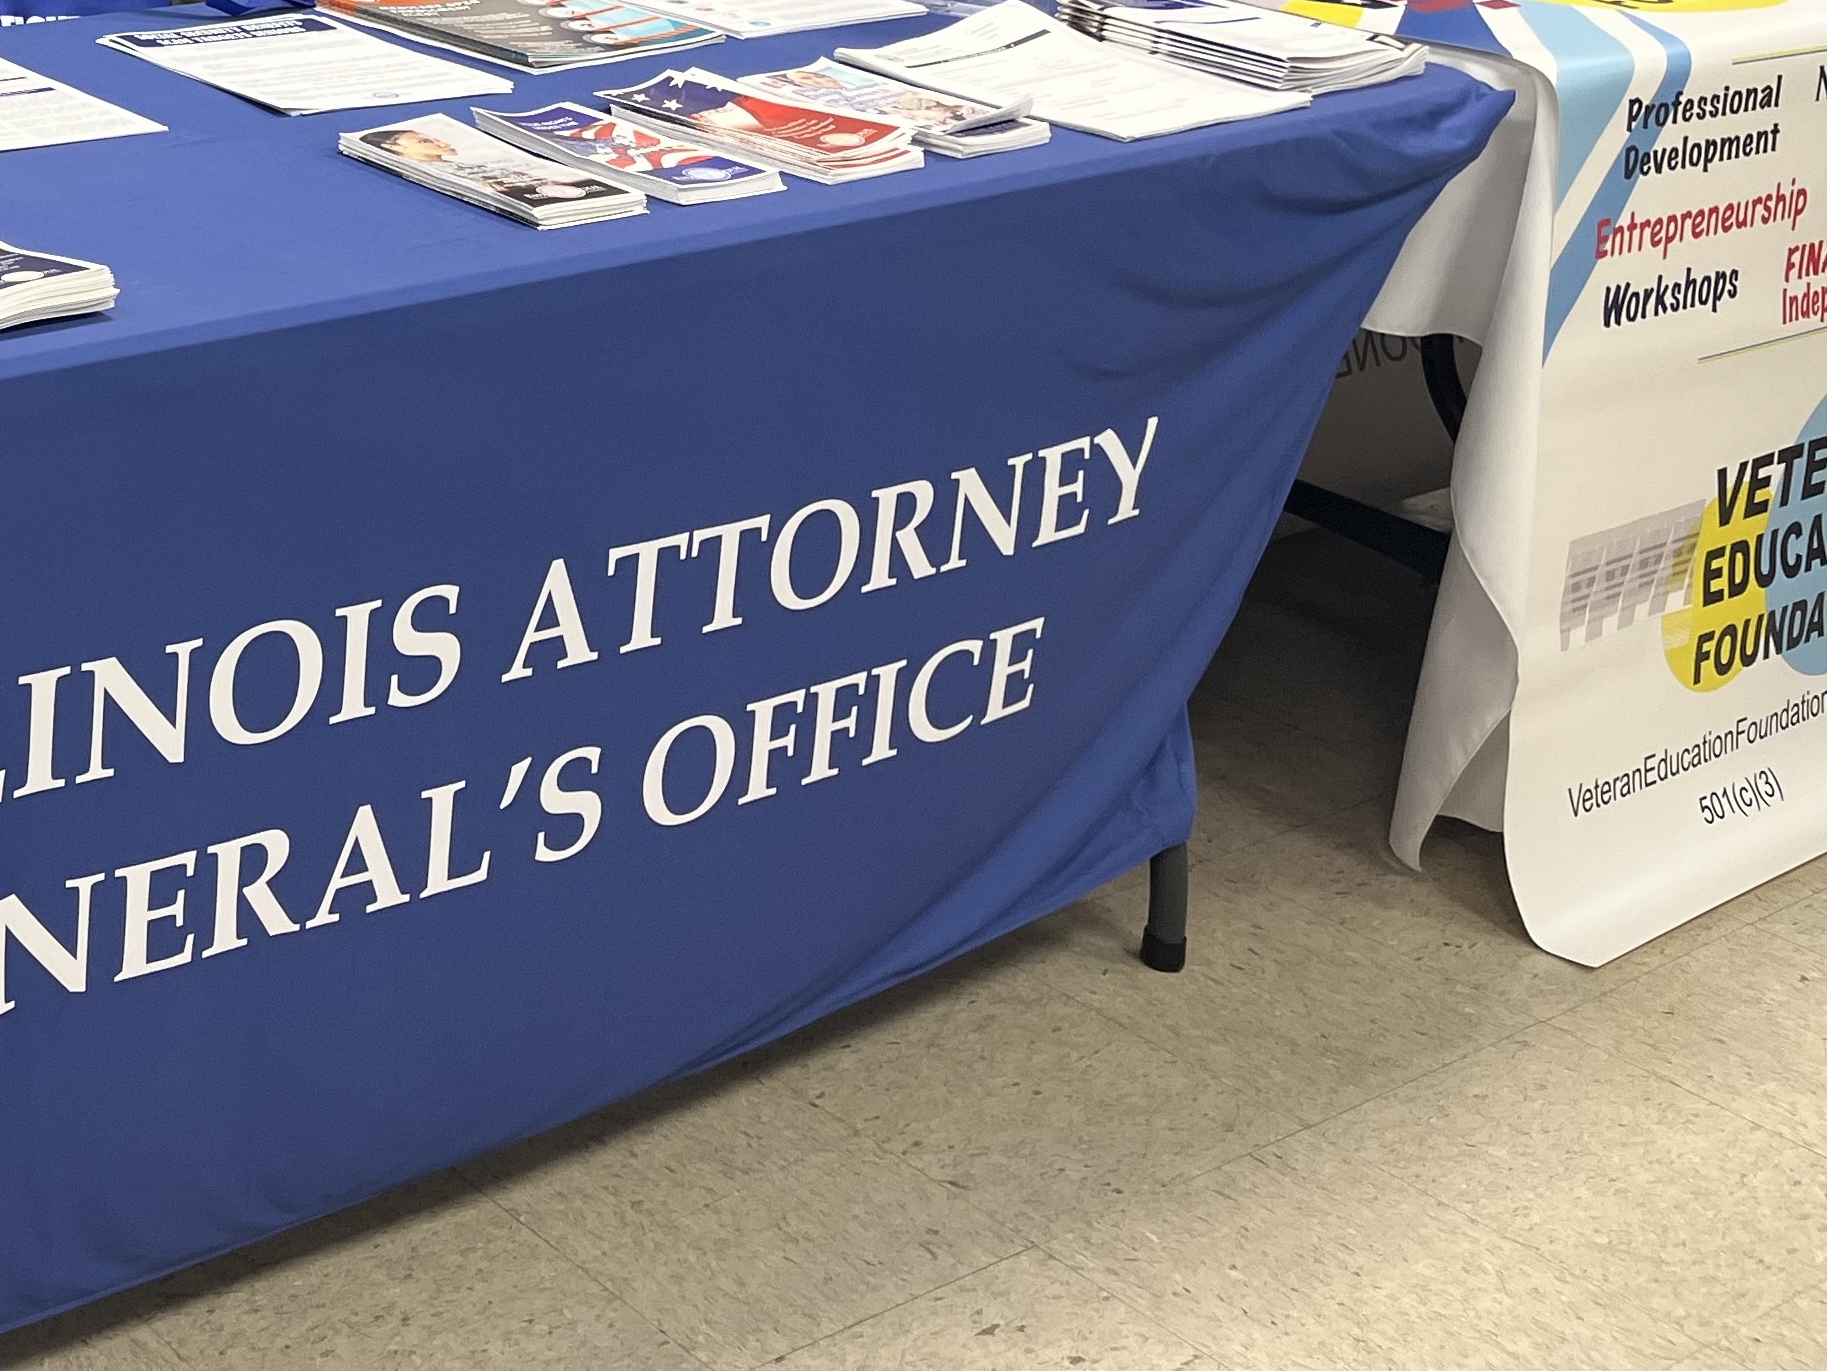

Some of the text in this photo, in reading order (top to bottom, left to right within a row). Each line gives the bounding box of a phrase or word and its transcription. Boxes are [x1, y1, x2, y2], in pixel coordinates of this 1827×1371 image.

[1626, 74, 1782, 133] Professional
[1623, 123, 1780, 180] Development
[1594, 177, 1808, 260] Entrepreneurship
[1602, 267, 1738, 328] Workshops
[1715, 436, 1827, 528] VETE
[501, 416, 1158, 683] ATTORNEY
[1702, 515, 1827, 608] EDUCA
[1693, 591, 1827, 686] FOUNDA
[642, 617, 1045, 826] OFFICE
[1568, 688, 1827, 818] VeteranEducationFoundation
[1699, 766, 1785, 826] 501(c)(3)
